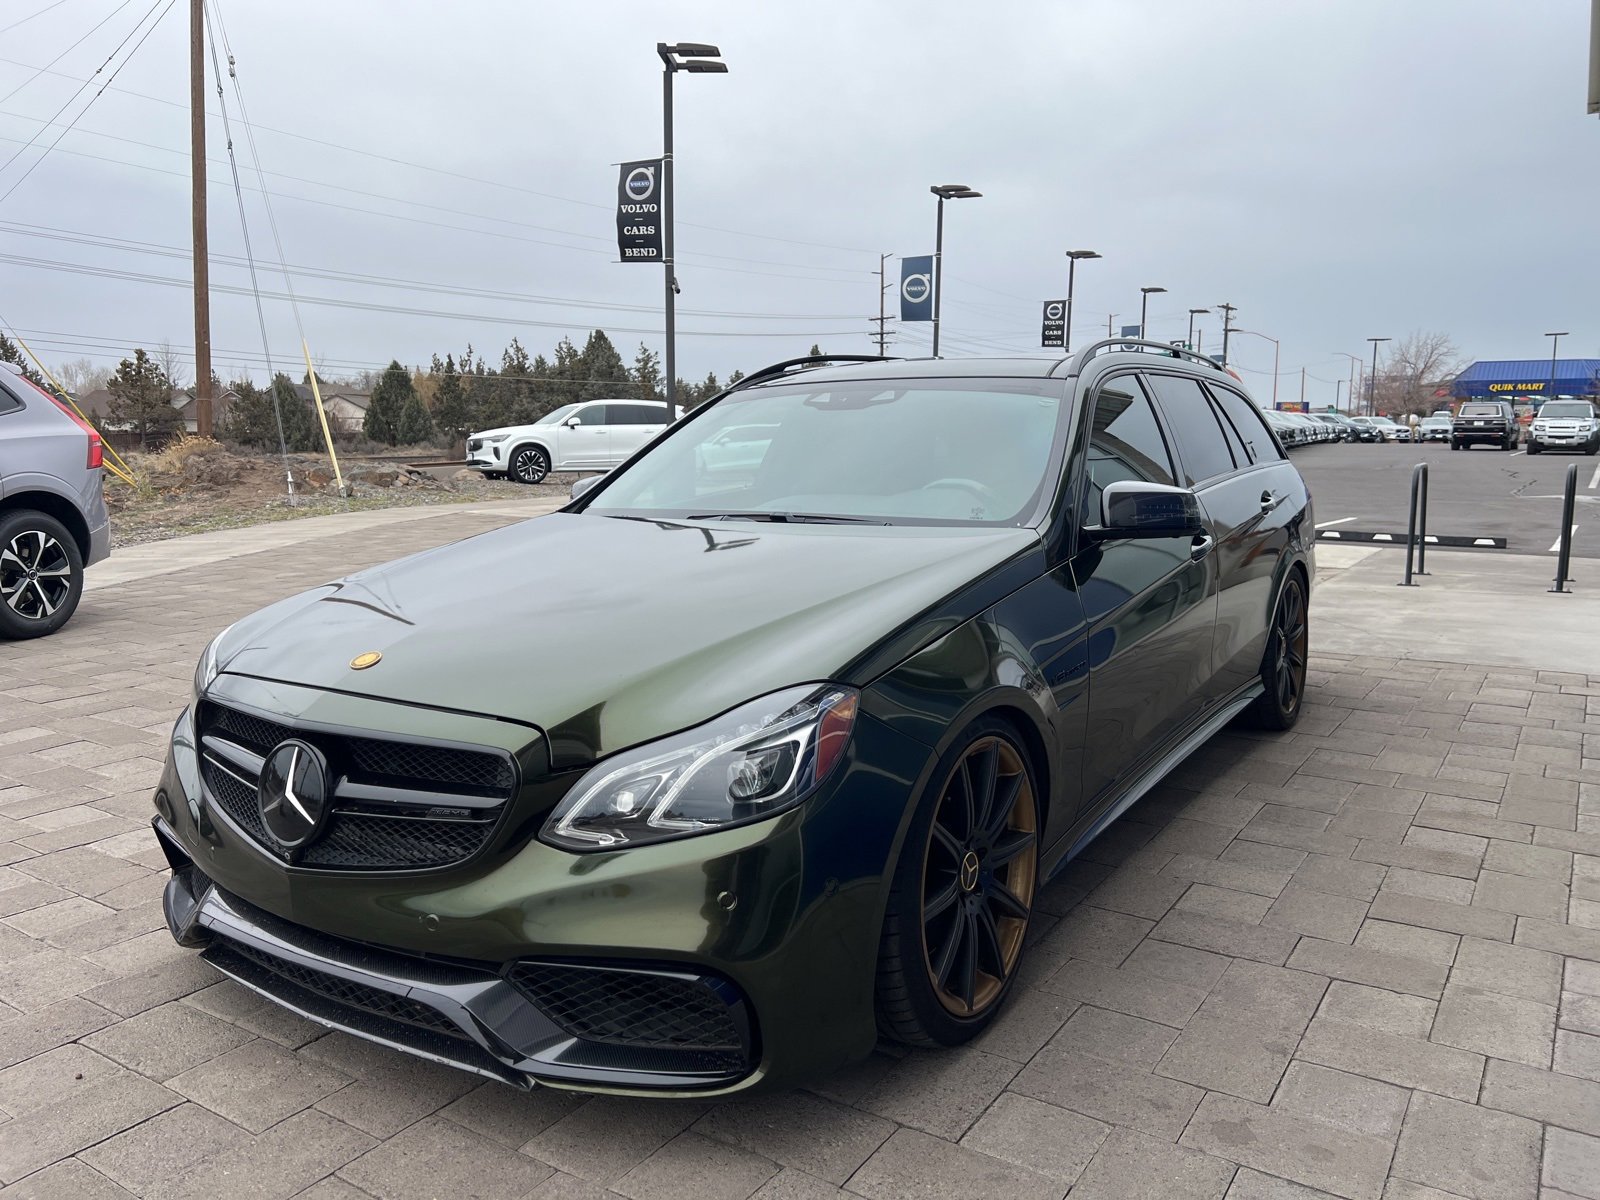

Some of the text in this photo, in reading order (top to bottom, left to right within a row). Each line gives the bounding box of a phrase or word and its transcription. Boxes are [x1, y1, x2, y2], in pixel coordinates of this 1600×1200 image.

[621, 204, 658, 213] VOLVO
[624, 226, 655, 235] CARS
[625, 248, 657, 257] BEND
[1488, 382, 1545, 392] QUIK MART
